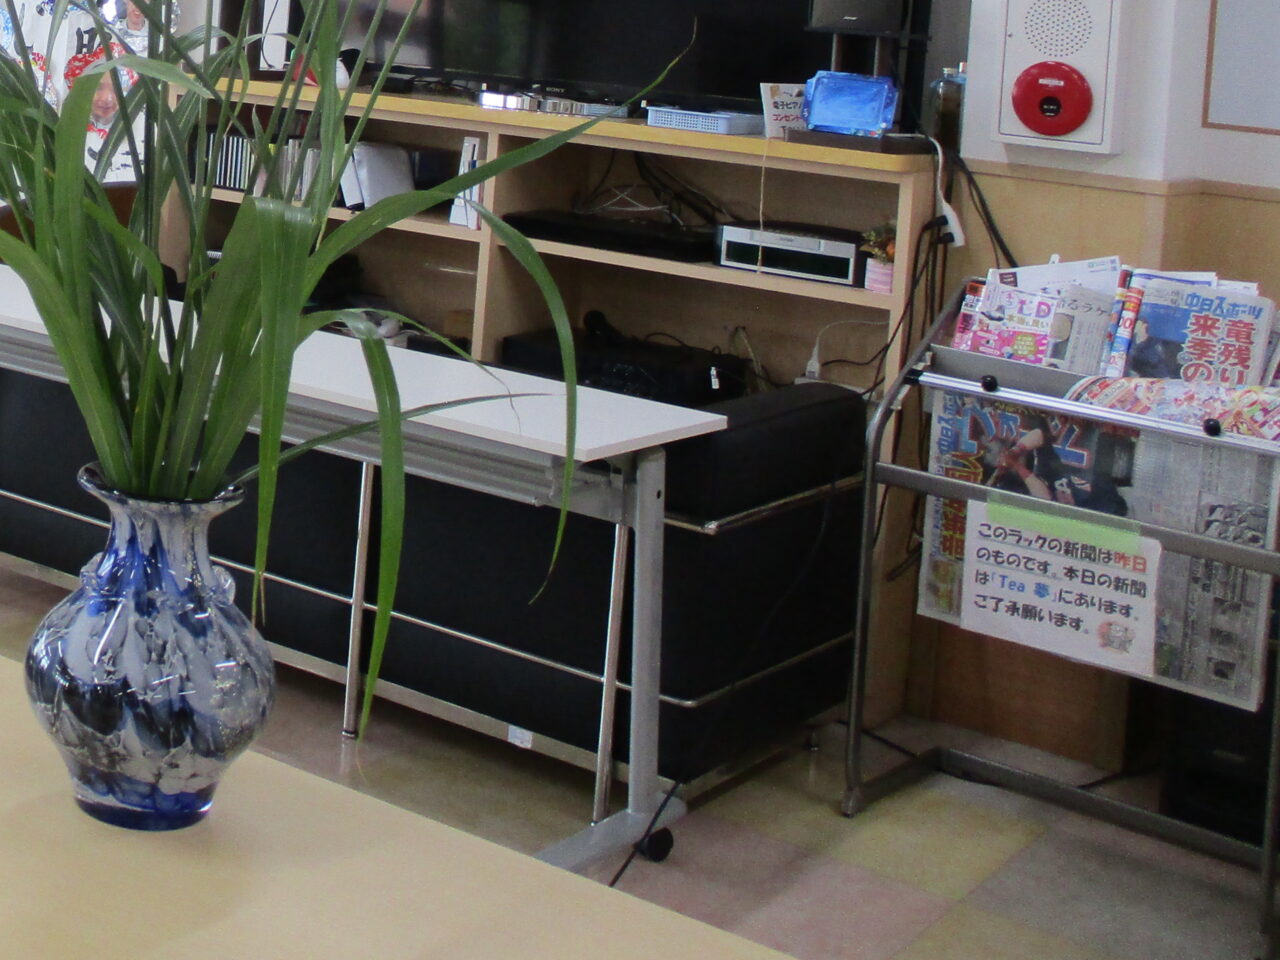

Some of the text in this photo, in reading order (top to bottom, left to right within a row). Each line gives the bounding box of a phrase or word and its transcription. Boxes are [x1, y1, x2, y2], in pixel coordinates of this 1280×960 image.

[975, 546, 1147, 599] のものです。本日の新聞
[977, 522, 1147, 573] このラックの新聞は昨日
